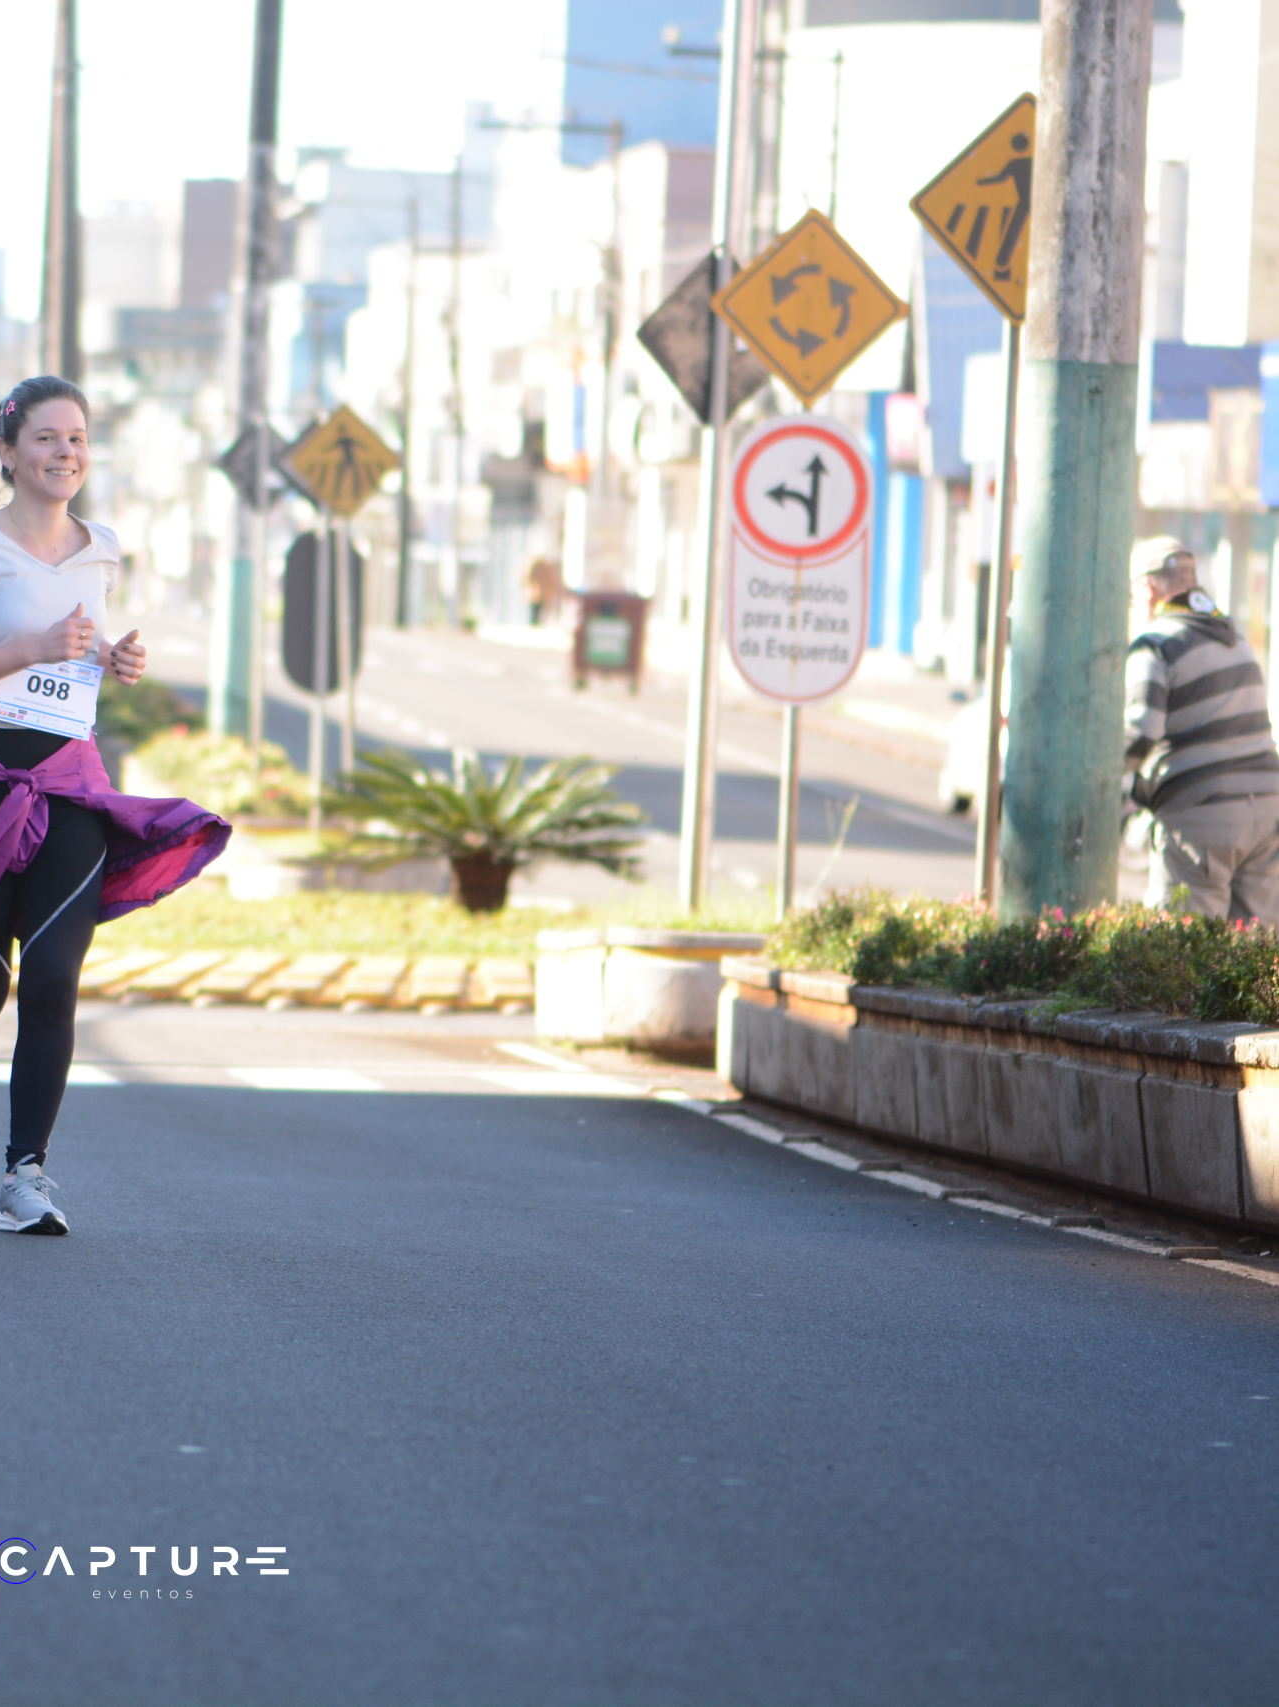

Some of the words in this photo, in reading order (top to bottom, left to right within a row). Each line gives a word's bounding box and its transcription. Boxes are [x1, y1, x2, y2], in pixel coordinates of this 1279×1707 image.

[748, 578, 848, 605] Obrigatório
[743, 611, 781, 631] para
[786, 615, 798, 630] a
[802, 611, 849, 633] Faixa
[739, 638, 761, 657] da
[766, 638, 849, 664] Esquerda
[27, 675, 70, 700] 098
